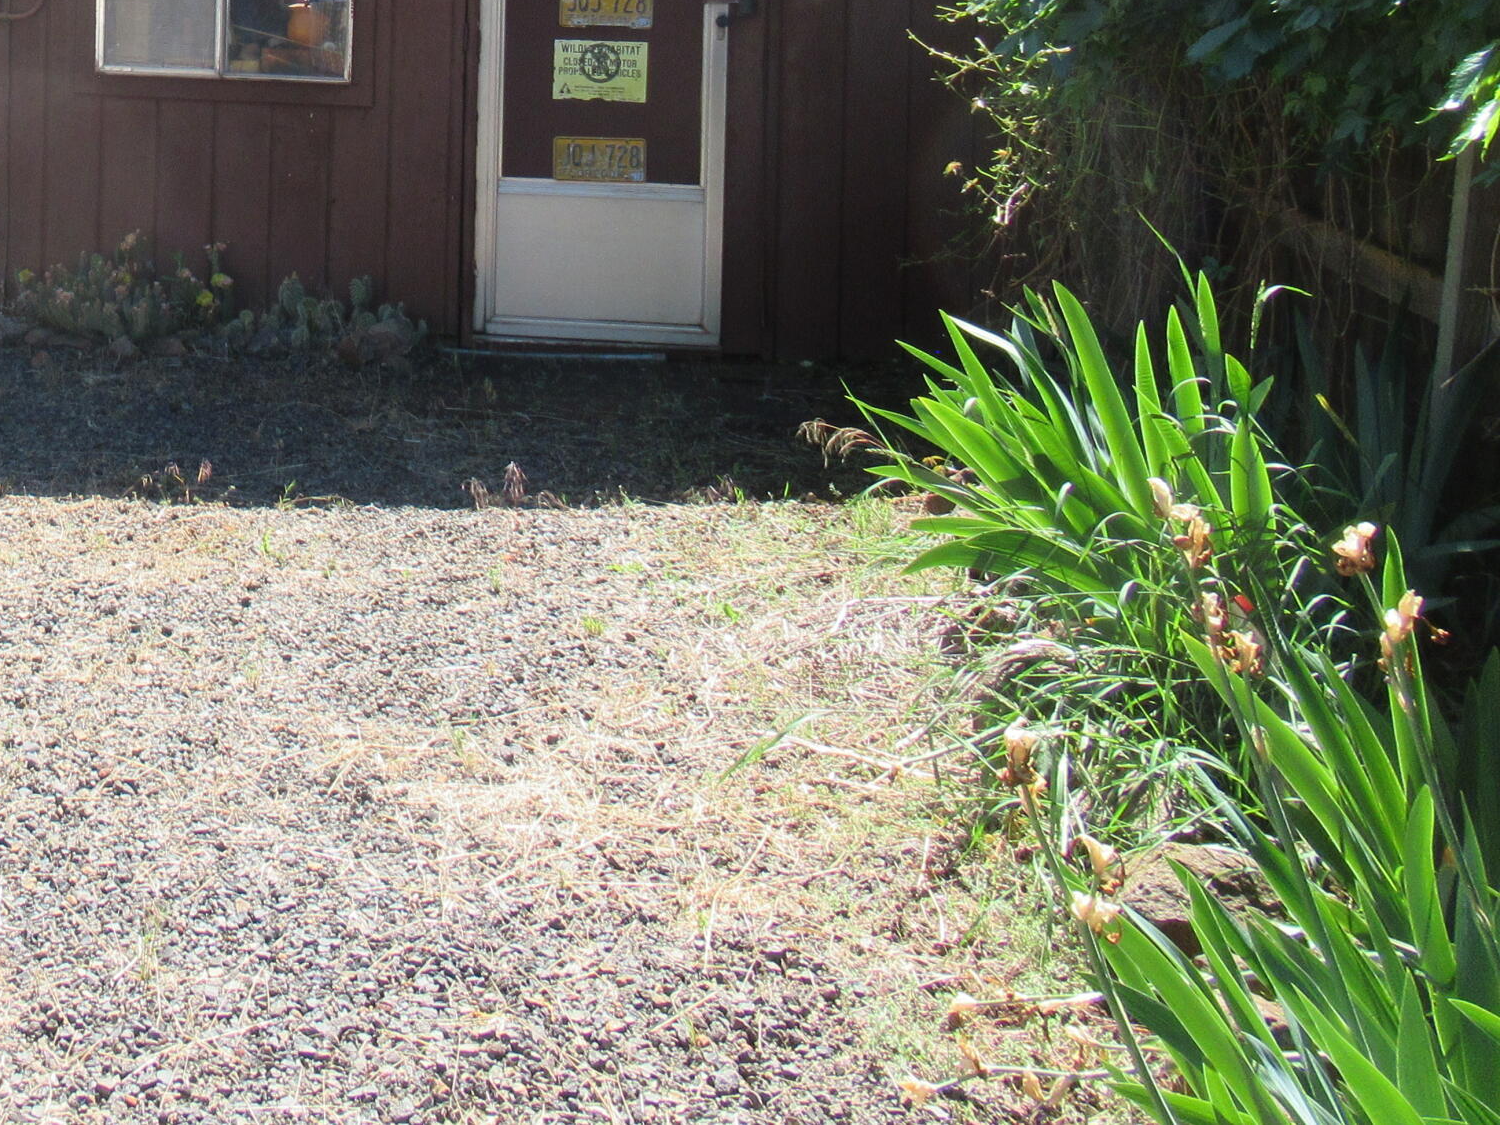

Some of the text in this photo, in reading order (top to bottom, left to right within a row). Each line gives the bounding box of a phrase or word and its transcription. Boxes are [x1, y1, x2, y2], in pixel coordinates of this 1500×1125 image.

[558, 67, 642, 78] PROPELED EICLES
[605, 144, 640, 169] 728
